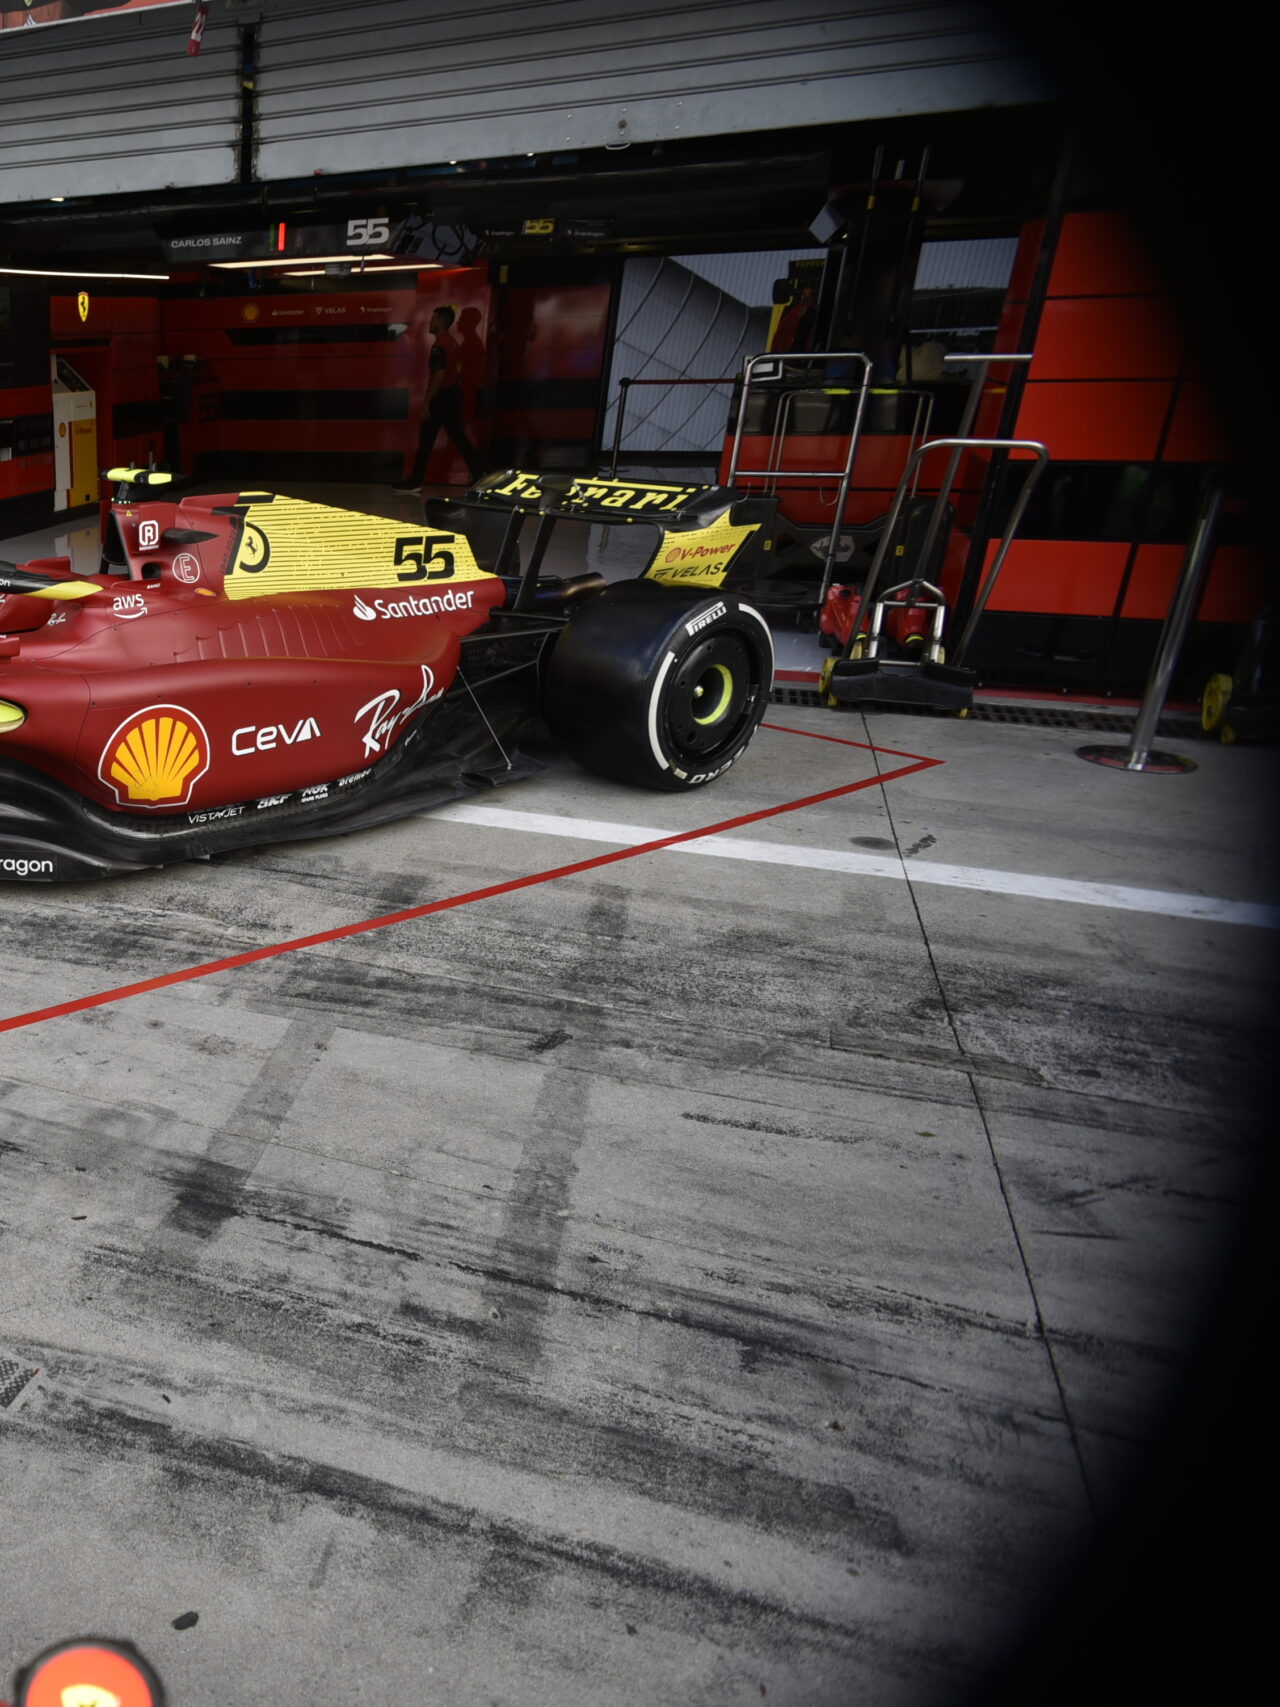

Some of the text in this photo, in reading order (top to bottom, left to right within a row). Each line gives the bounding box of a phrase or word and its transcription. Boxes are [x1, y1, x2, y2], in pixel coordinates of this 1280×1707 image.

[346, 217, 390, 246] 55
[523, 218, 555, 235] 55
[171, 236, 242, 249] CARLOS SAINZ
[394, 534, 455, 583] 55
[680, 543, 736, 561] V-Power
[671, 562, 723, 579] VELAS
[113, 593, 144, 611] aws
[375, 590, 474, 620] Santander
[685, 601, 727, 637] PIRELLI
